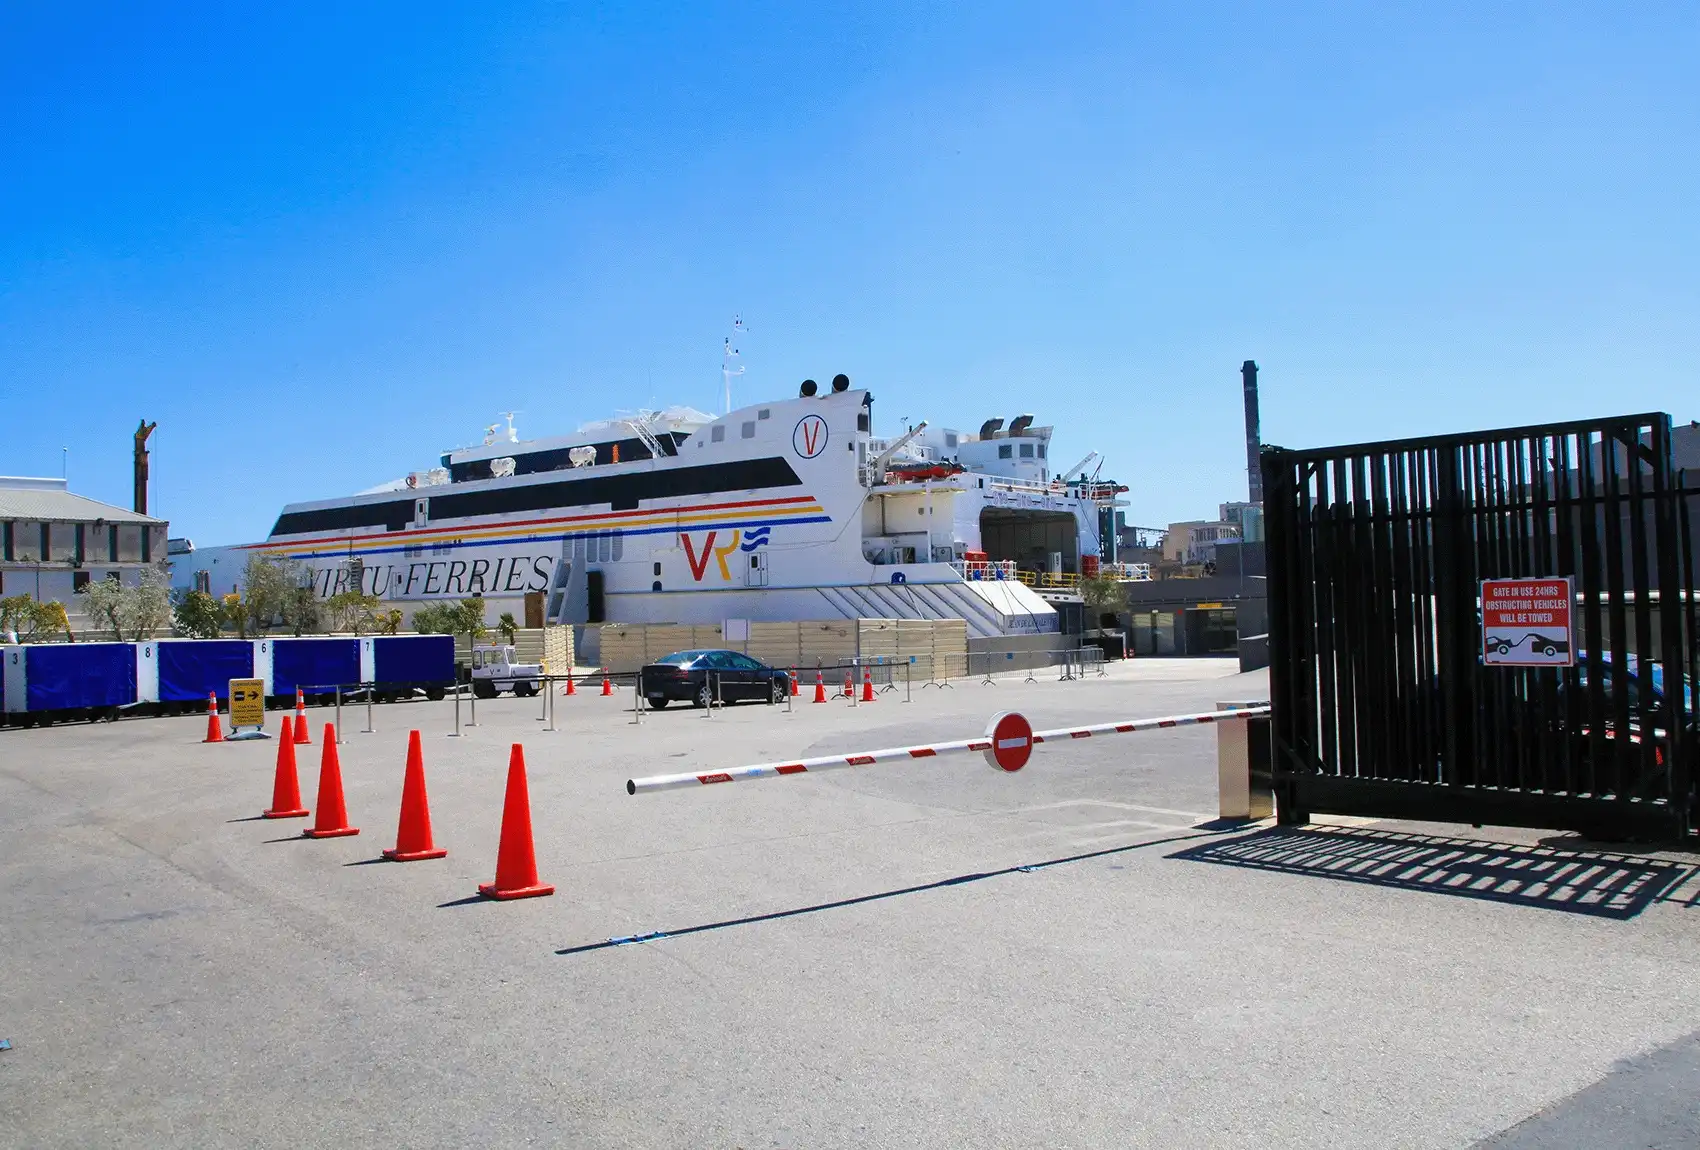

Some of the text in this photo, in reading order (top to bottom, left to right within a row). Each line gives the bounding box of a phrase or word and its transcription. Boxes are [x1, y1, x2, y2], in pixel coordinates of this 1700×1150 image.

[803, 420, 820, 455] V
[403, 555, 554, 595] FERRIES
[1493, 586, 1558, 597] GATE IN USE 24HRS
[1485, 599, 1567, 610] OBSTRUCTING VEHICLES
[1500, 613, 1553, 623] WILL BE TOWED
[145, 647, 151, 658] 8
[261, 643, 267, 653] 6
[12, 652, 18, 665] 3
